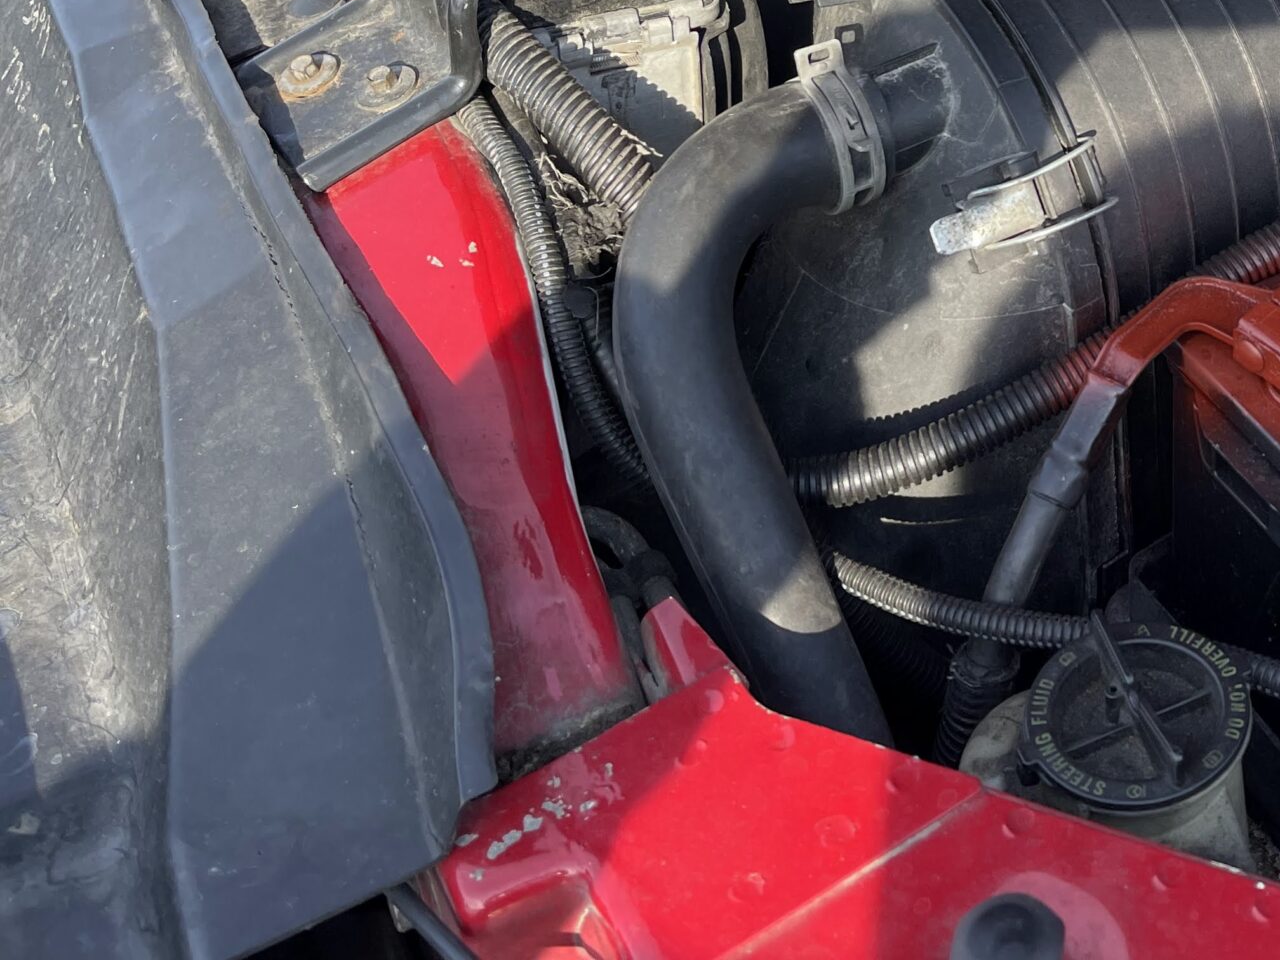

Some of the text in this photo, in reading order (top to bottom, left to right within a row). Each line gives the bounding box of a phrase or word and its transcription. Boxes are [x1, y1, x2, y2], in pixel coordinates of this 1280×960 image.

[1170, 625, 1237, 678] OVERFILL
[1030, 679, 1107, 796] STEERING FLUID
[1224, 717, 1245, 740] DO
